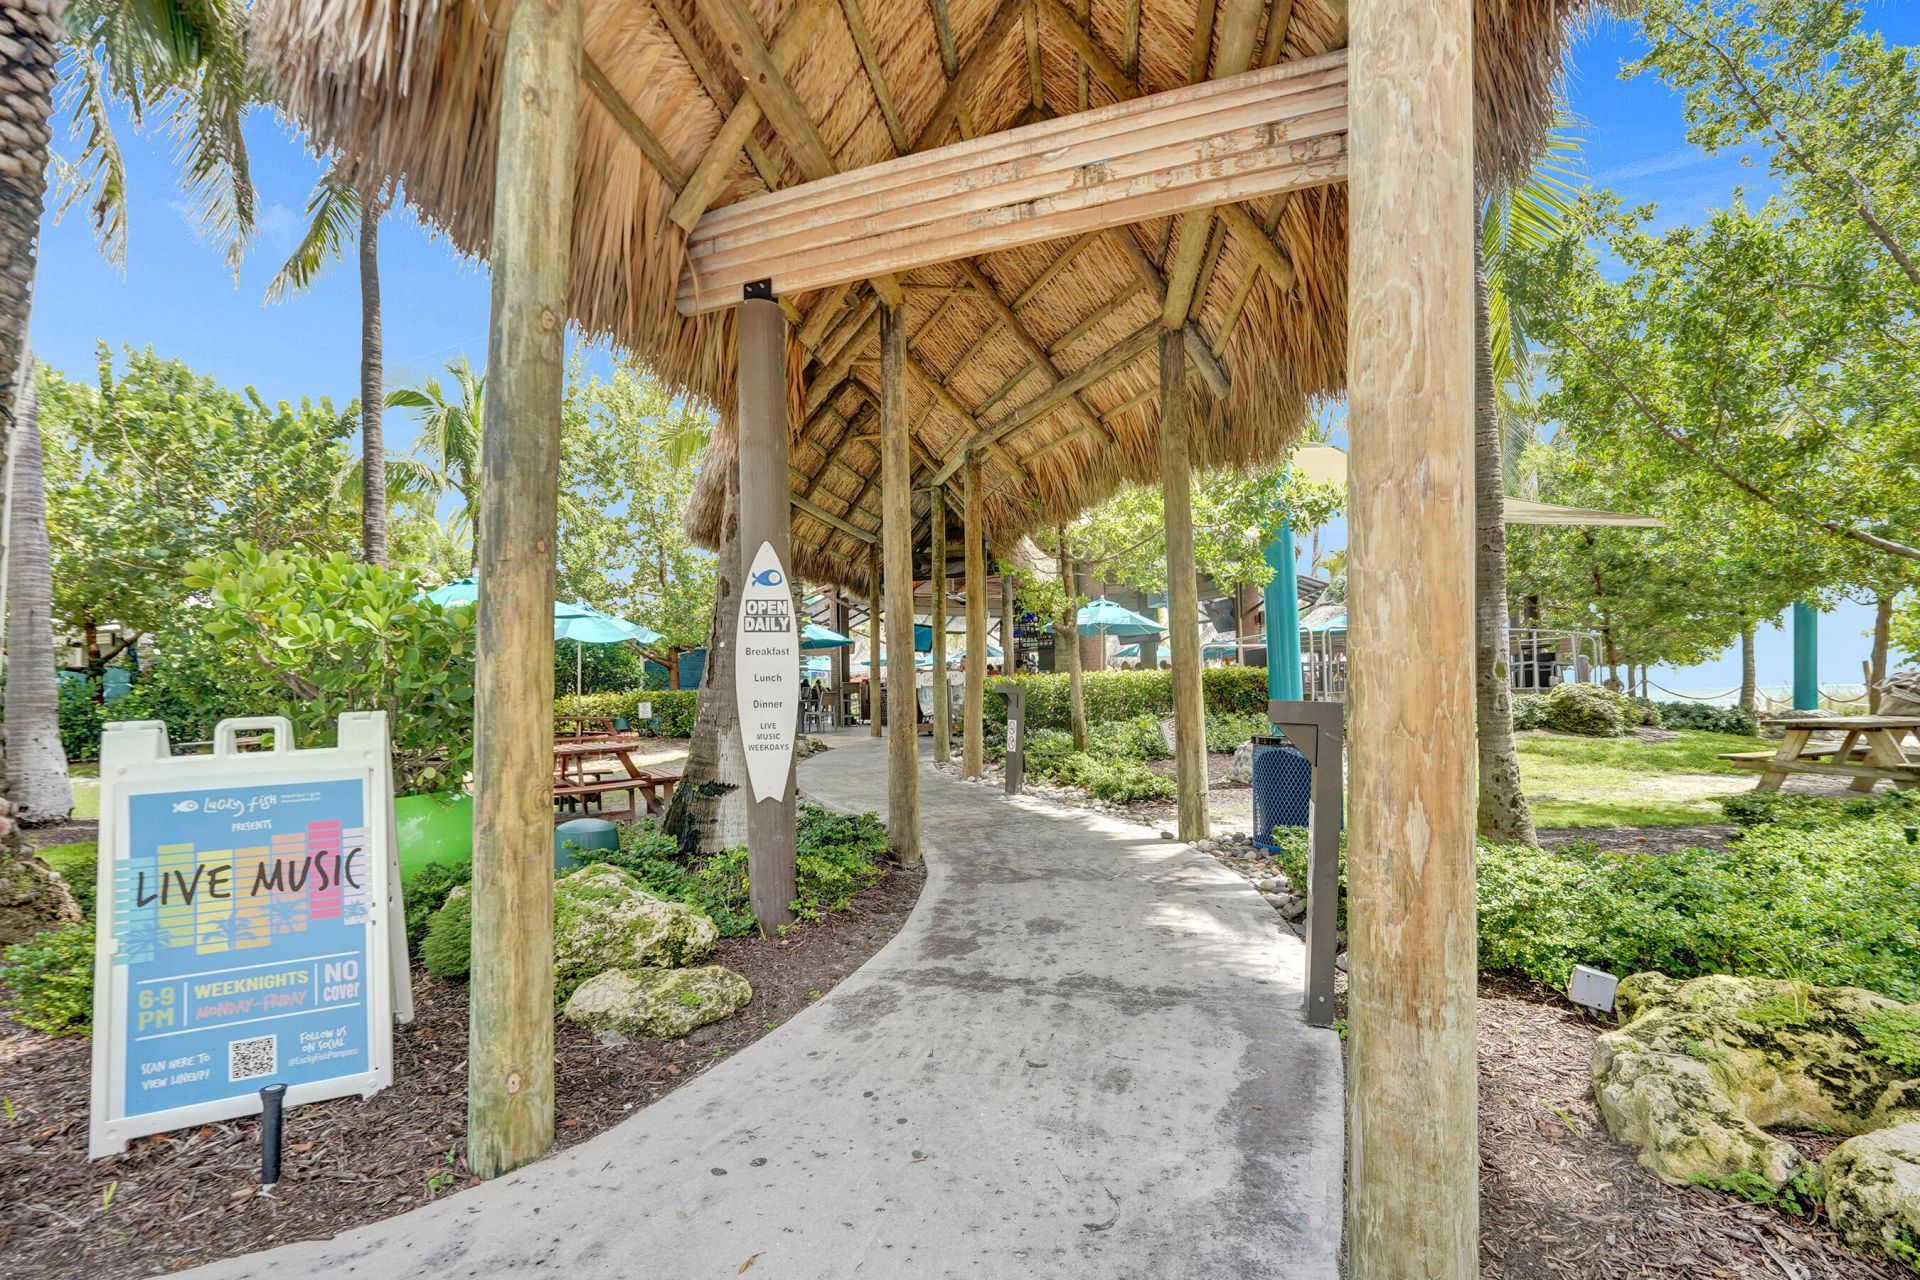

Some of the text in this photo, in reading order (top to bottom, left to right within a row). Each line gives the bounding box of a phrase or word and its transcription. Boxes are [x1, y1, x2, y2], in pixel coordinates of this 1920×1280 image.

[746, 600, 788, 615] OPEN
[744, 616, 790, 632] DAILY
[745, 647, 790, 656] Breakfast
[754, 673, 782, 682] Lunch
[753, 700, 783, 709] Dinner
[760, 722, 777, 730] LIVE
[756, 733, 781, 741] MUSIC
[748, 744, 790, 752] WEEKDAYS
[231, 819, 272, 832] PRESENTS
[136, 847, 362, 908] LIVE MUSIC
[325, 959, 358, 984] NO
[194, 970, 309, 999] WEEKNIGHTS
[138, 986, 175, 1009] 6-9
[138, 1007, 174, 1031] PM
[336, 1025, 348, 1037] US
[140, 1060, 166, 1075] SCAN
[168, 1056, 195, 1069] HERE
[141, 1077, 168, 1091] VIEW
